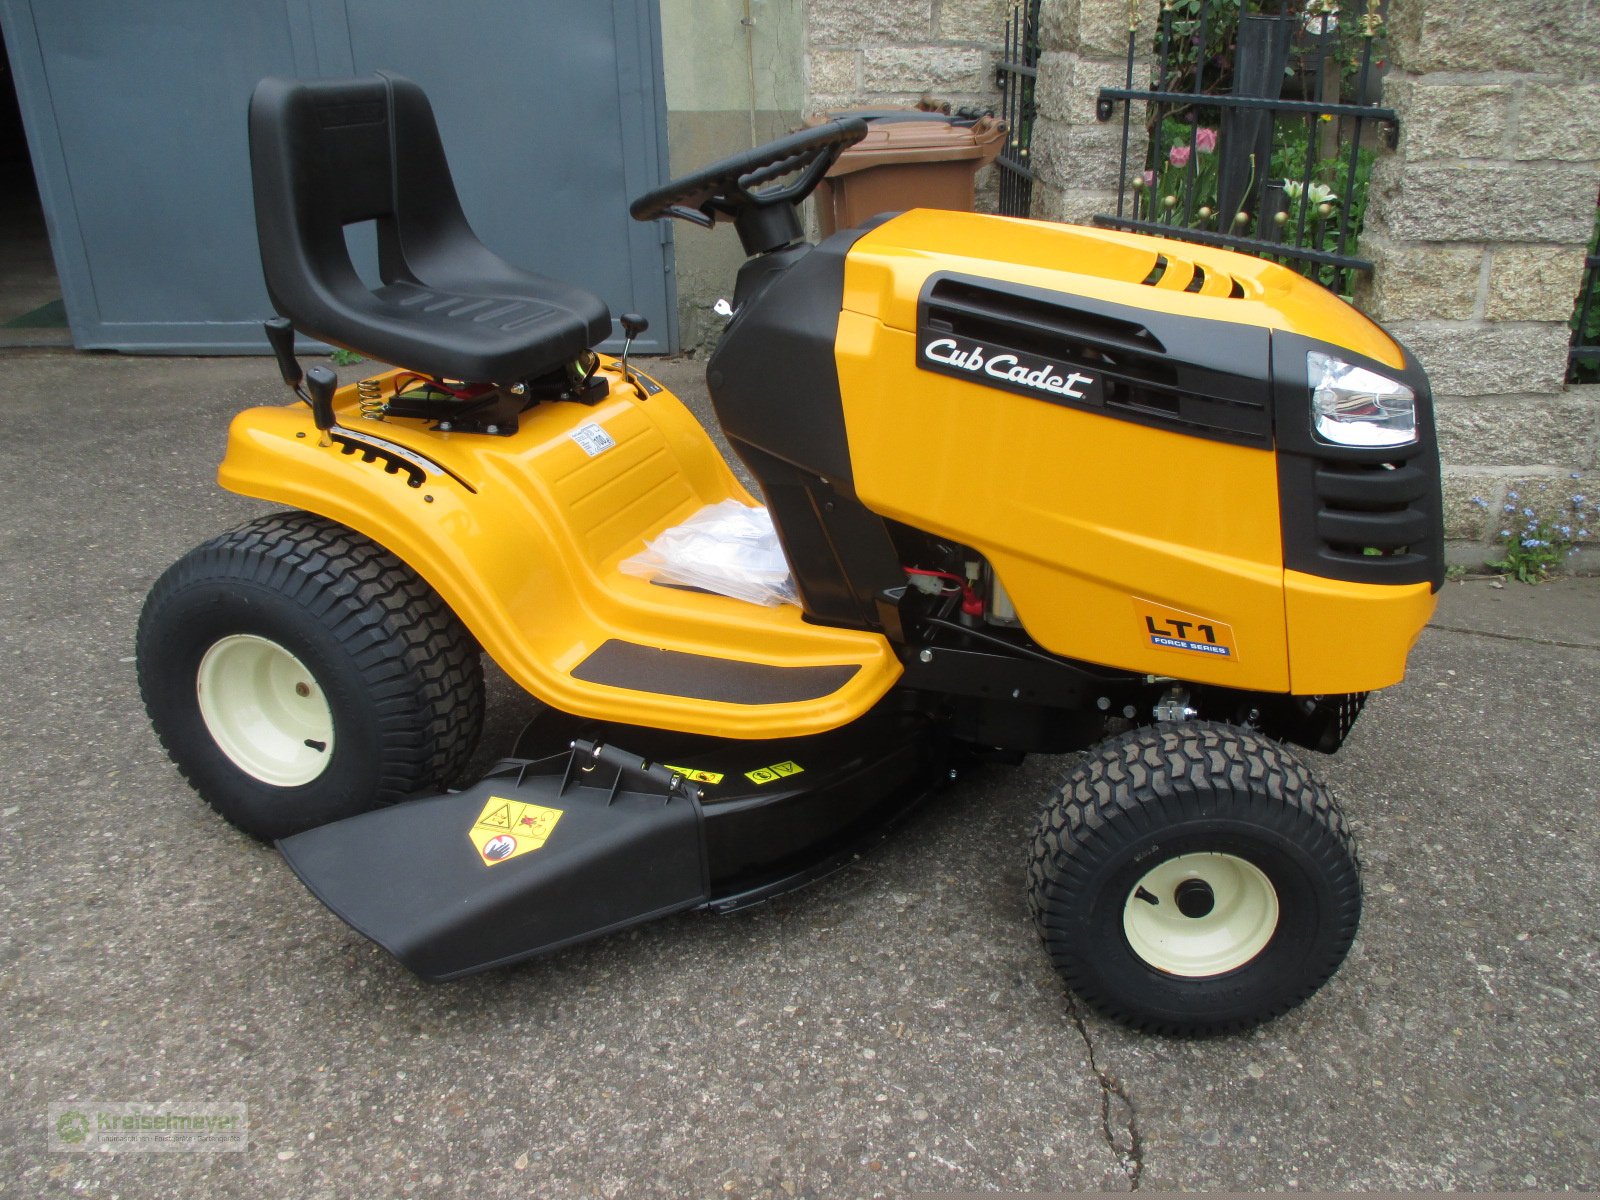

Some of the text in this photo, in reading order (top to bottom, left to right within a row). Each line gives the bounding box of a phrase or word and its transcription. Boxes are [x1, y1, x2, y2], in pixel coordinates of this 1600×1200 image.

[925, 338, 1094, 399] Cub Cadet
[1145, 615, 1216, 643] LT1
[1154, 637, 1226, 654] FORCE SERIES
